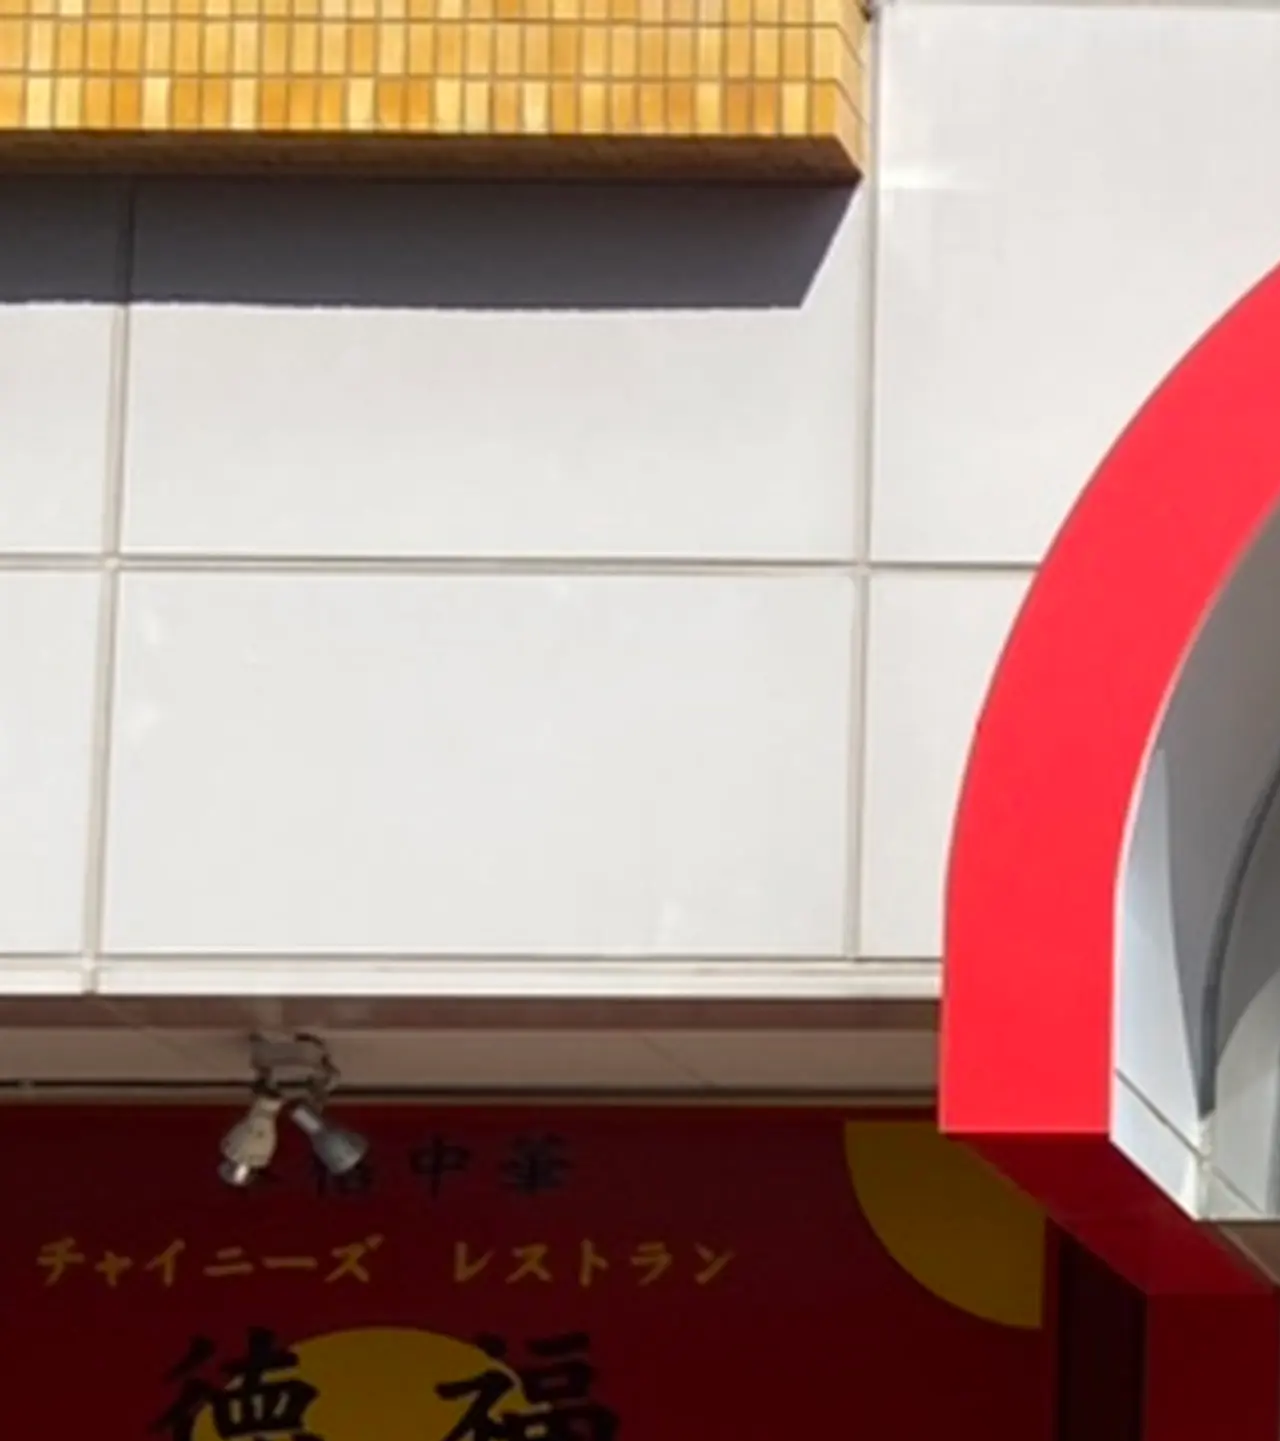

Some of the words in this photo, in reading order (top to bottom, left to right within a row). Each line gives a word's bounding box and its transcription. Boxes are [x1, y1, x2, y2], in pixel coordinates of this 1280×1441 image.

[37, 1234, 384, 1286] チャイニーズ
[453, 1240, 737, 1286] レストラン
